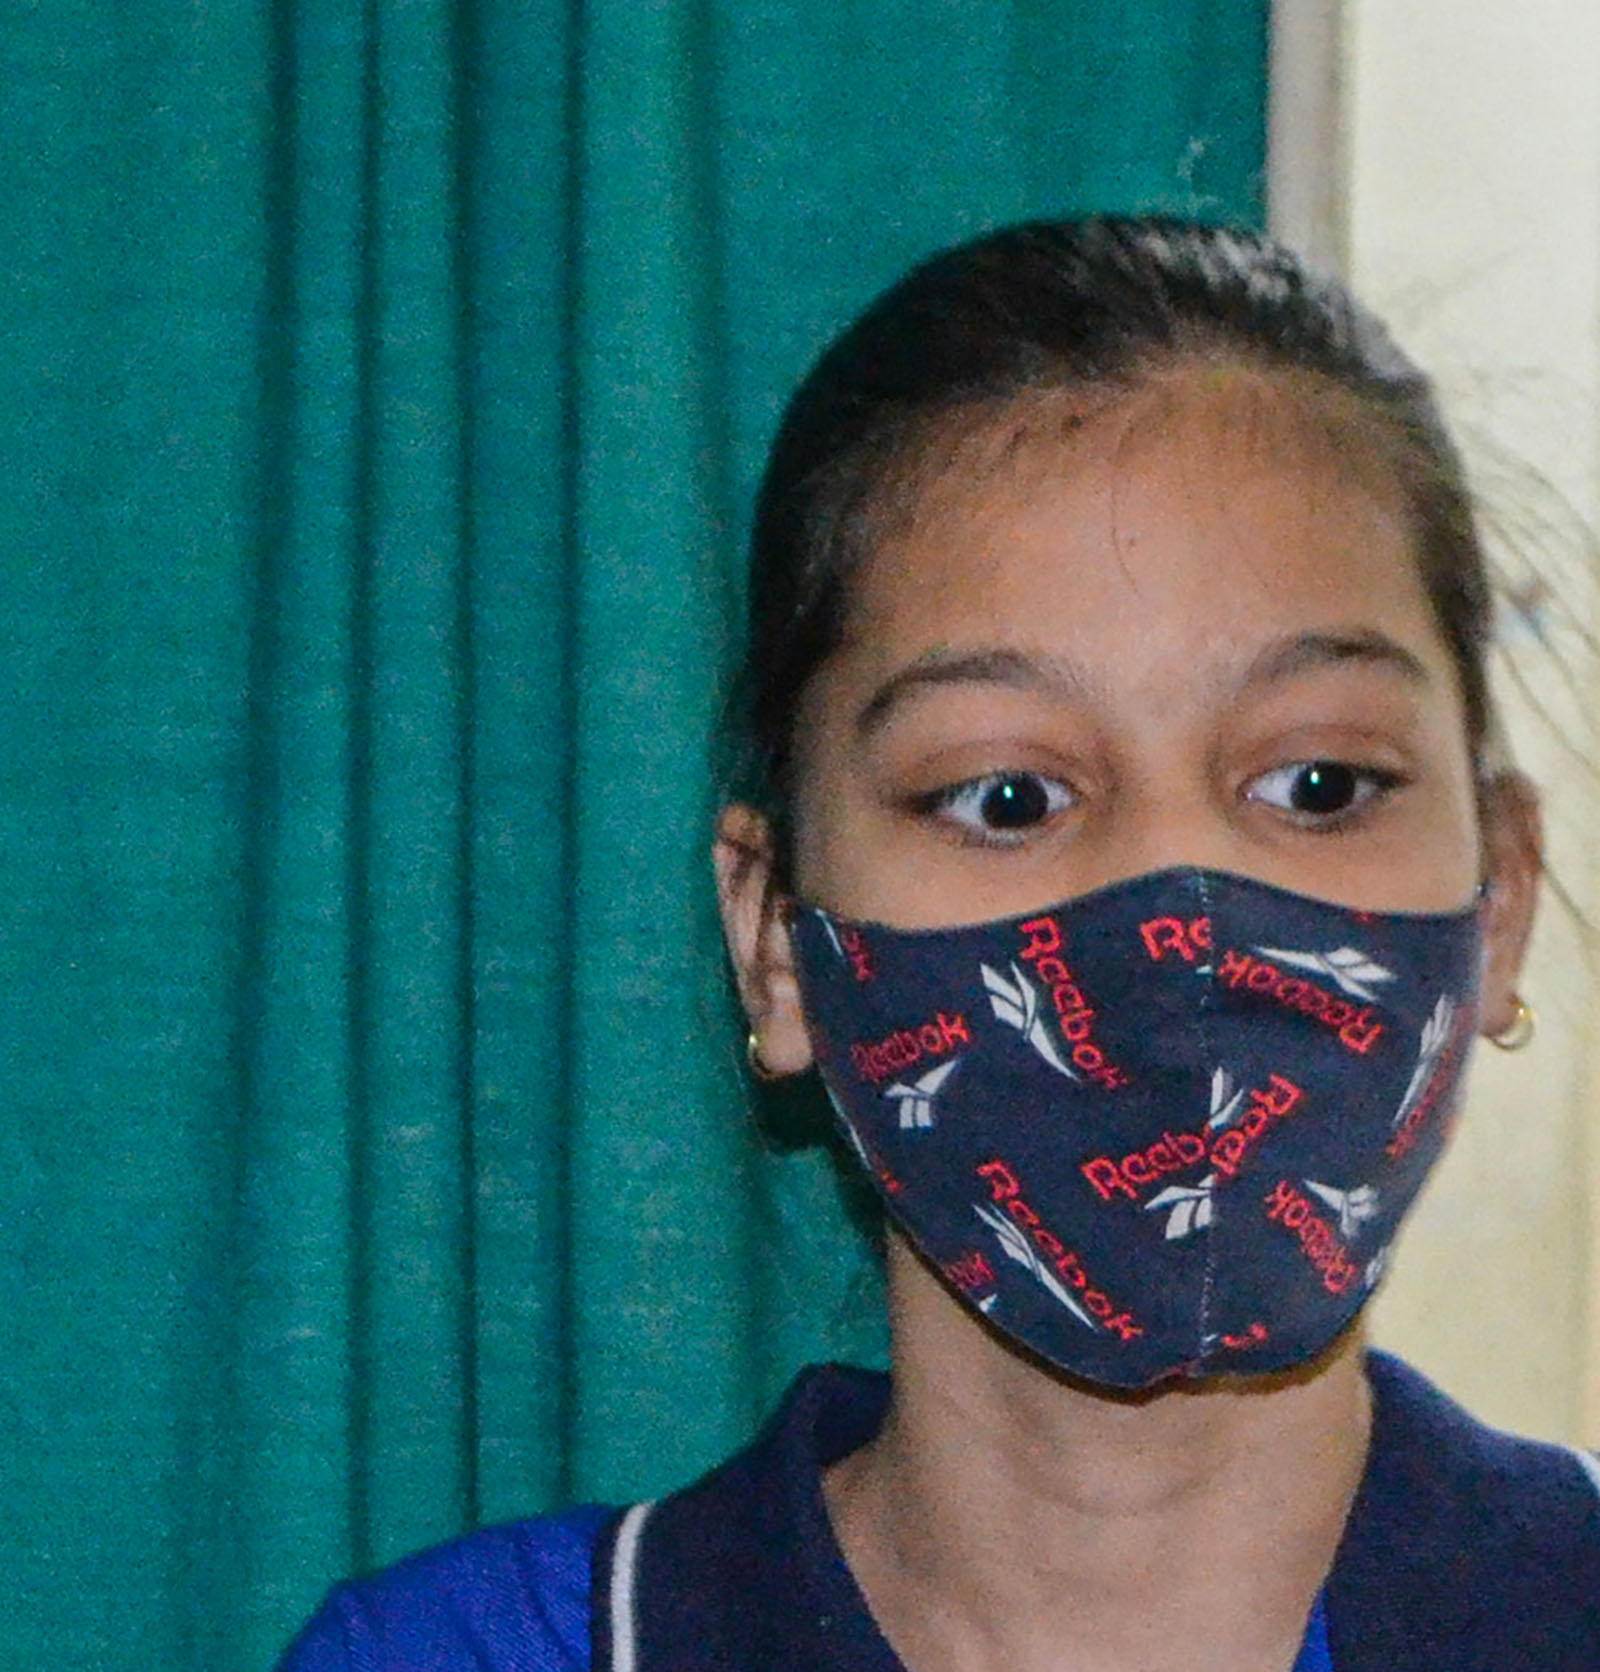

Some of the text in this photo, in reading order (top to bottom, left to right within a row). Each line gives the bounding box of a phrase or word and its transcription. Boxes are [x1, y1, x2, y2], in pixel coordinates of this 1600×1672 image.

[1021, 916, 1130, 1090] Reebok
[1218, 950, 1383, 1054] Reebok
[976, 1161, 1143, 1340] Reebok
